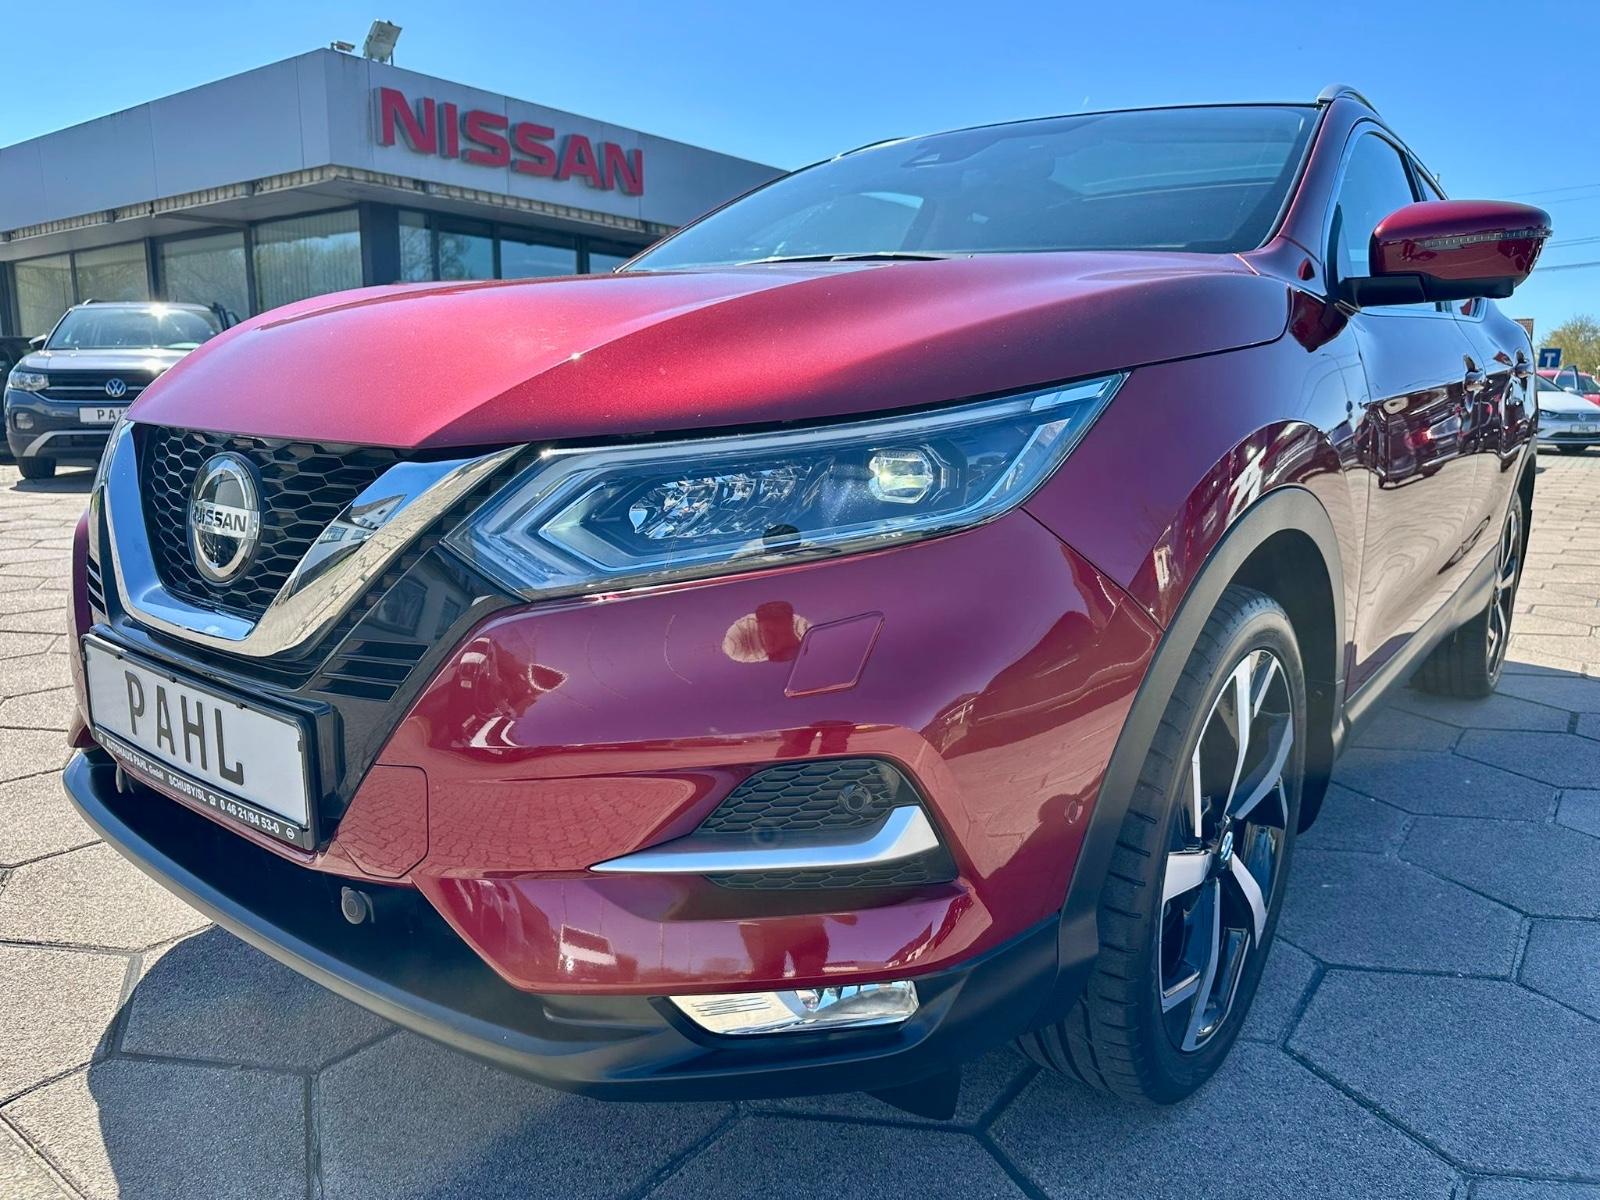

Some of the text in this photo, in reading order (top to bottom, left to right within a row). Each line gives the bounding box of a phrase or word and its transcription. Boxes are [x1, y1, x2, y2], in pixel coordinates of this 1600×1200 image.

[376, 87, 643, 196] NISSAN
[193, 505, 247, 532] NISSAN
[124, 670, 243, 785] PAHL
[168, 774, 207, 802] SCHUBY/SL
[220, 799, 226, 811] 0
[226, 803, 237, 815] 46
[238, 806, 260, 826] 21/94
[261, 817, 280, 834] 53-0
